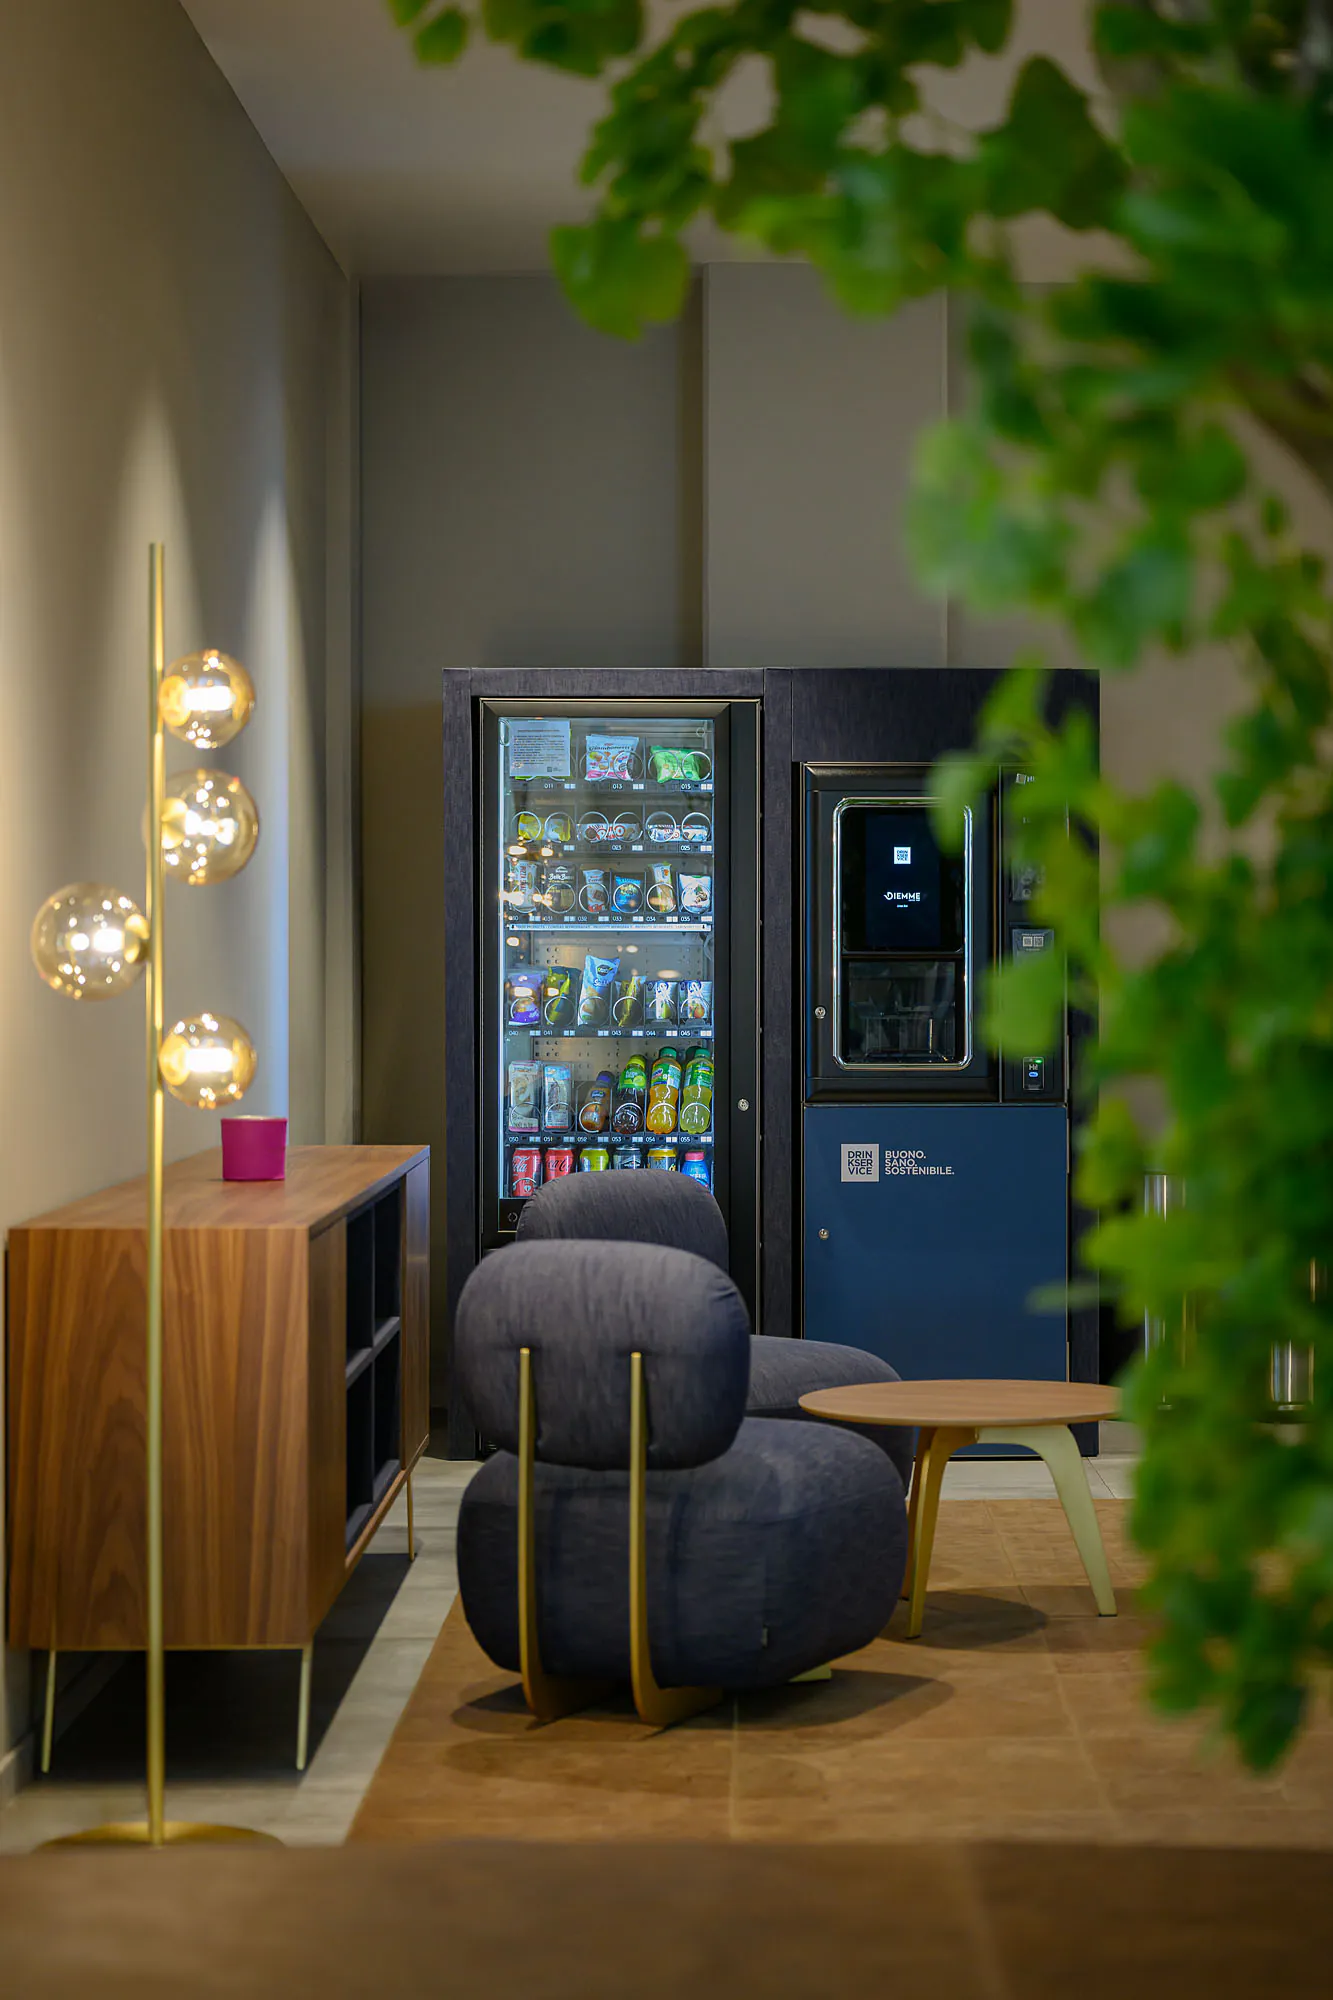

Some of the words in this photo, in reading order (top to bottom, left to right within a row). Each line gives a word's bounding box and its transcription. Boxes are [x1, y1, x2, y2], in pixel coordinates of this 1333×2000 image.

[883, 891, 921, 900] DIEMME
[847, 1151, 873, 1159] DRIN
[885, 1150, 927, 1159] BUONO.
[847, 1159, 873, 1167] KSER
[885, 1159, 918, 1167] SANO.
[848, 1167, 873, 1175] VICE
[884, 1166, 955, 1175] SOSTENIBILE.
